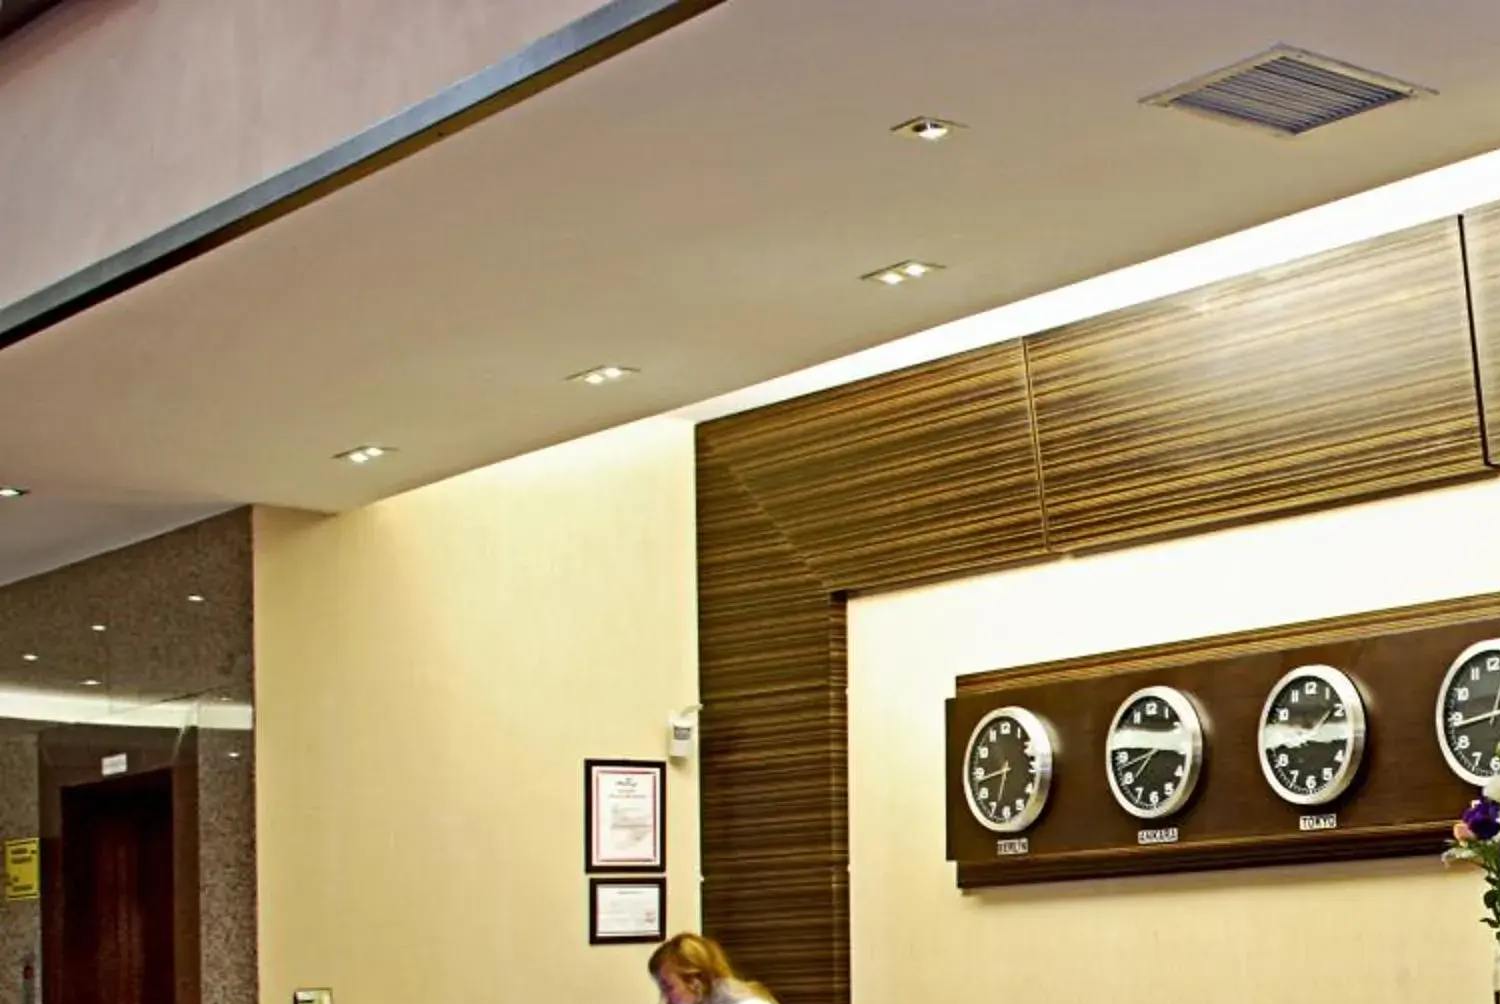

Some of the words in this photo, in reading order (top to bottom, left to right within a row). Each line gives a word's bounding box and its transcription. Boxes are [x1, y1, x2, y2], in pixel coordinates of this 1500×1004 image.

[1486, 657, 1500, 672] 12
[1471, 667, 1480, 680] 11
[1304, 682, 1317, 695] 12
[1454, 687, 1469, 701] 10
[1291, 690, 1299, 703] 11
[1333, 703, 1344, 717] 2
[1457, 735, 1470, 749] 8
[1279, 753, 1289, 767] 8
[1334, 749, 1344, 762] 4
[1471, 751, 1482, 771] 7
[1174, 765, 1184, 777] 4
[1323, 767, 1333, 781] 5
[1124, 772, 1134, 785] 8
[1290, 769, 1299, 788] 7
[1305, 775, 1317, 789] 6
[979, 787, 989, 799] 8
[1025, 782, 1034, 794] 4
[1135, 787, 1144, 803] 7
[1164, 782, 1174, 795] 5
[1149, 791, 1160, 804] 6
[989, 801, 997, 818] 7
[1002, 805, 1011, 819] 6
[1015, 799, 1024, 811] 5
